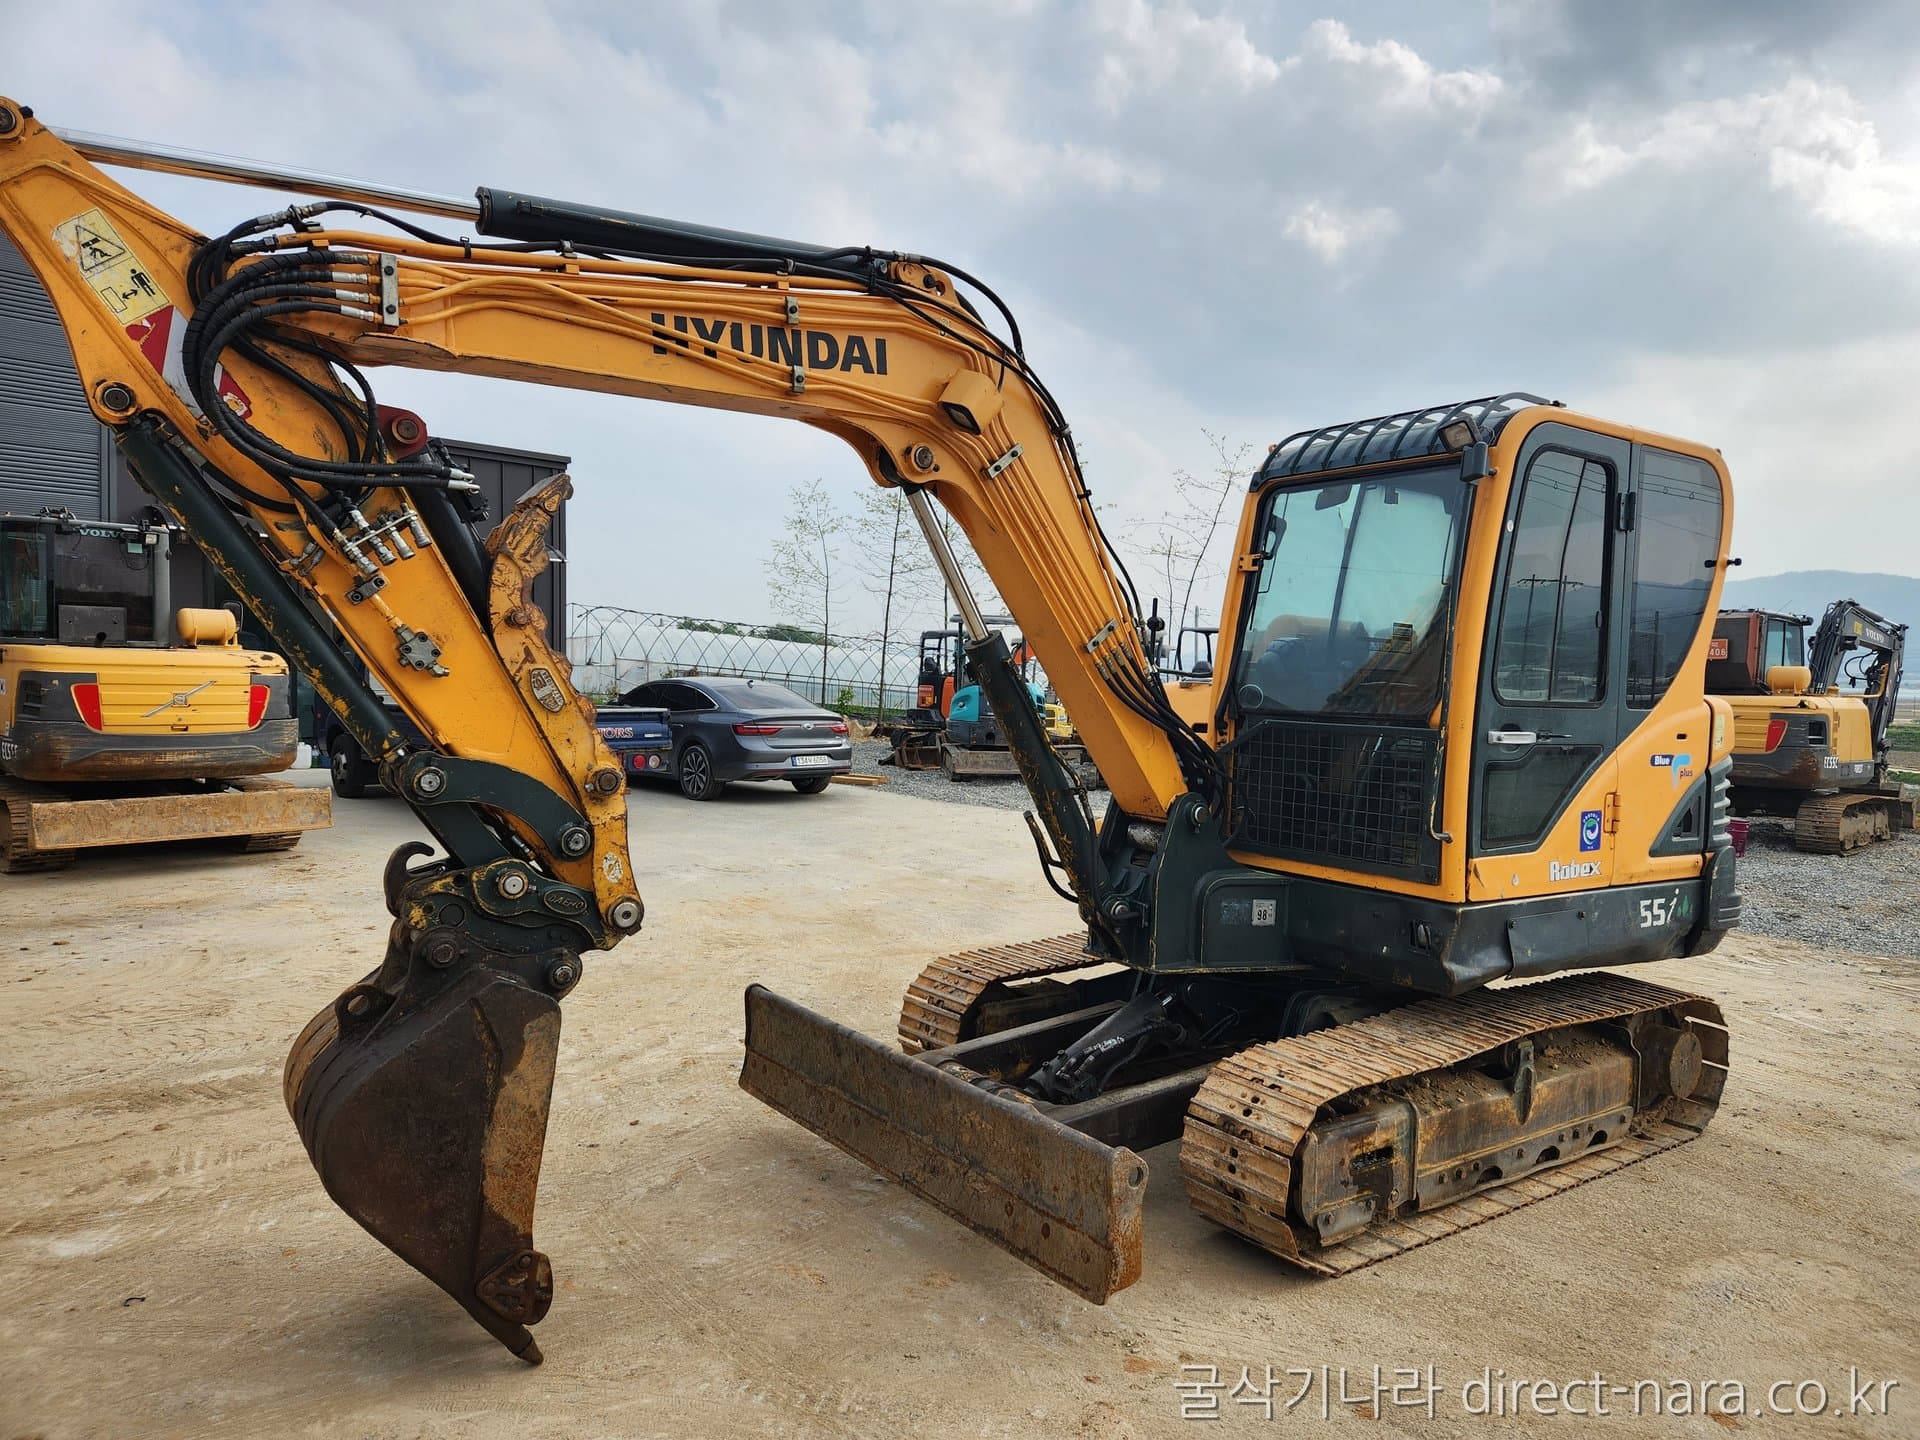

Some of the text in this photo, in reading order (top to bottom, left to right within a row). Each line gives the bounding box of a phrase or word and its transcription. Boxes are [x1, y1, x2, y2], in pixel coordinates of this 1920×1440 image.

[651, 312, 888, 376] HYUNDAI
[79, 528, 127, 538] VOLV
[1865, 627, 1885, 643] VOLVO
[1654, 755, 1670, 766] Blue
[1679, 768, 1693, 780] plus
[1549, 860, 1601, 882] Robex
[1256, 908, 1268, 921] 98
